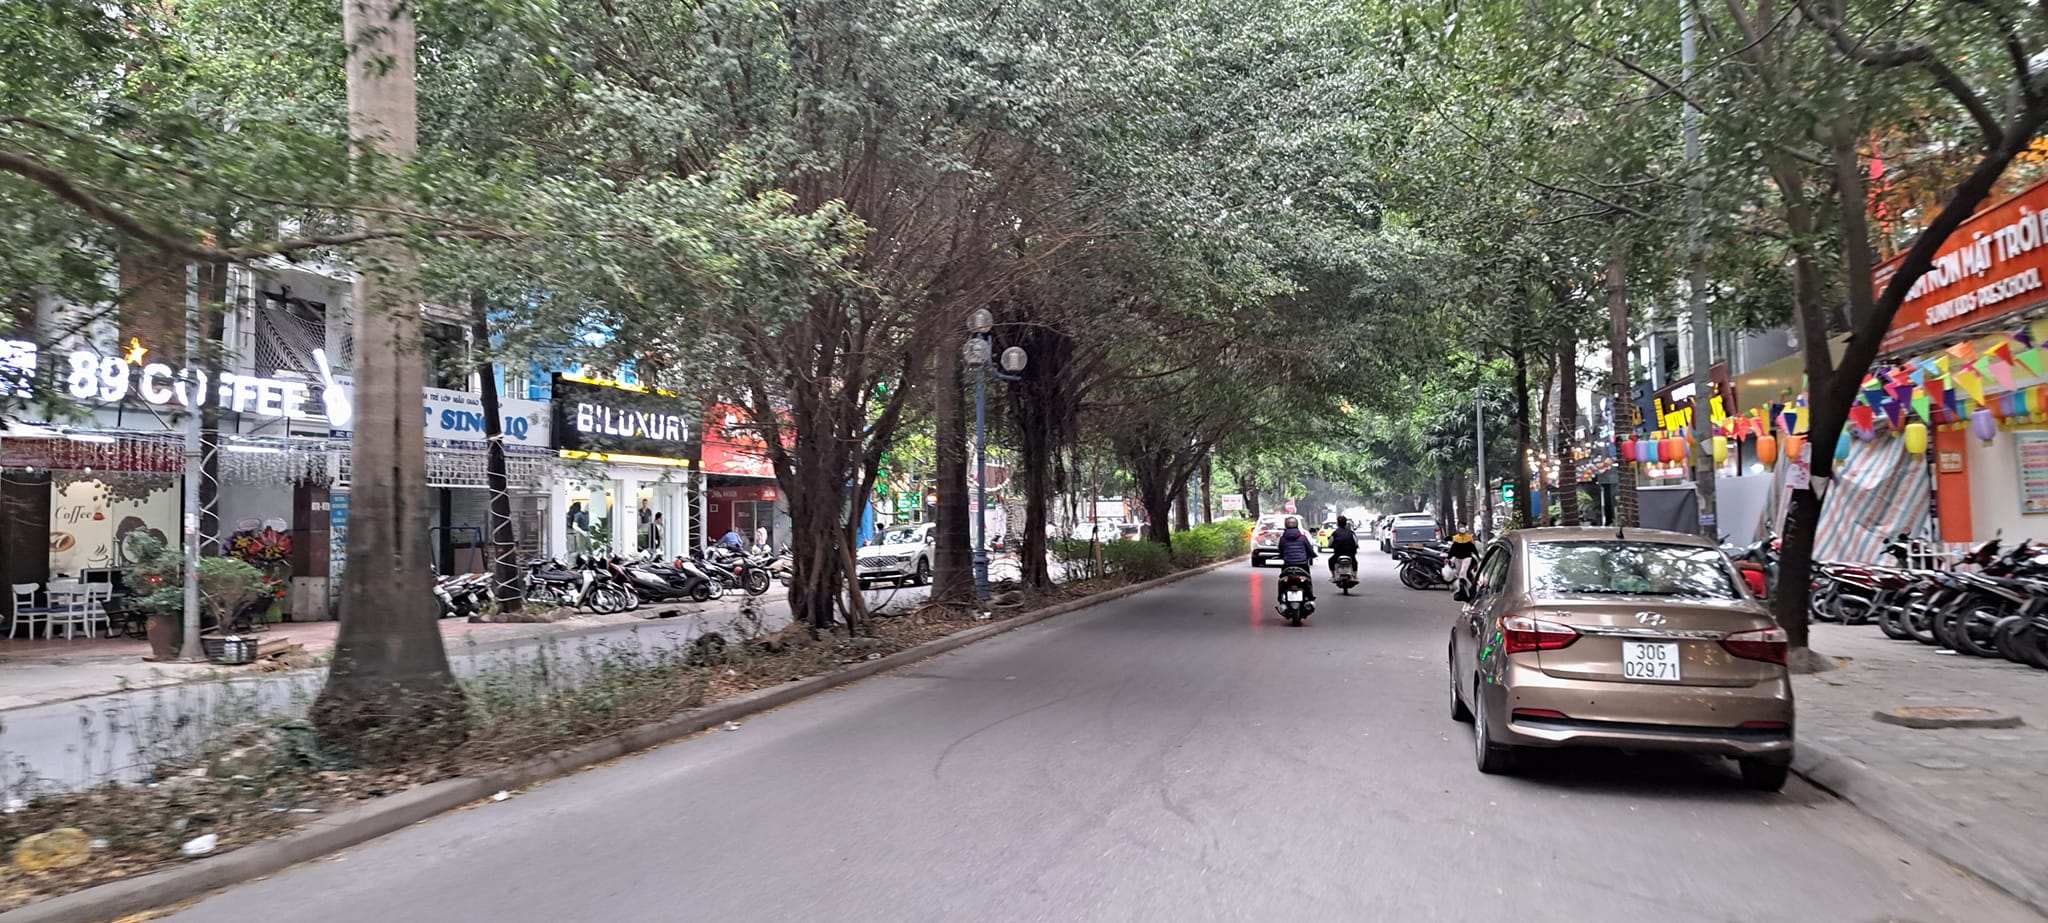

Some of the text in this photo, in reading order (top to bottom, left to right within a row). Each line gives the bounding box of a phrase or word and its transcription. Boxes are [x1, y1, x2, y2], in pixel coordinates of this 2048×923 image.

[1977, 267, 2042, 307] PRESCHOOL
[69, 351, 130, 402] 89
[504, 416, 528, 440] IQ
[54, 505, 93, 524] Coffee
[1636, 644, 1667, 661] 30G
[1625, 661, 1677, 679] 029.71
